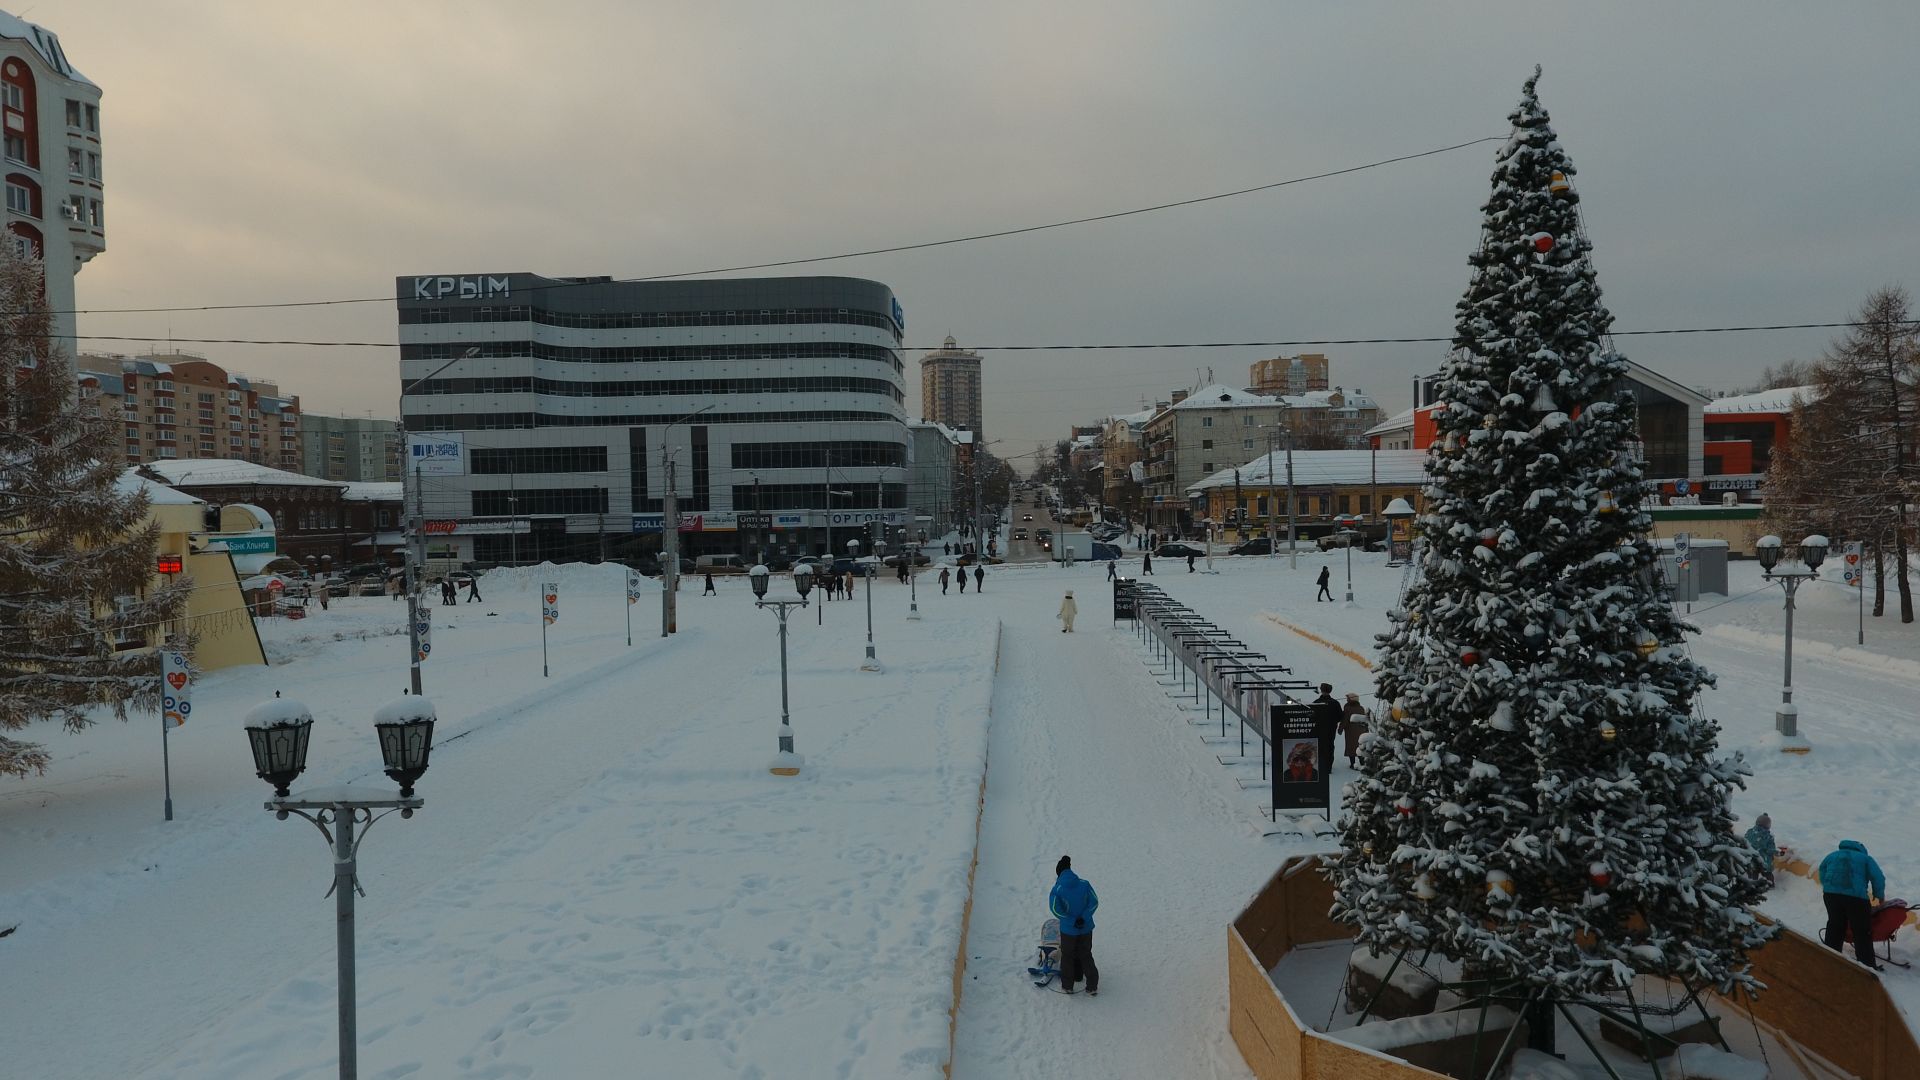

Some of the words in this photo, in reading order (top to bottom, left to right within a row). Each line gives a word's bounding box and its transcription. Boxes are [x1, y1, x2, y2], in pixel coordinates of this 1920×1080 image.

[414, 276, 511, 300] КРЫМ
[1708, 480, 1757, 490] ПЕКАРНЯ
[246, 541, 269, 549] Хлынов
